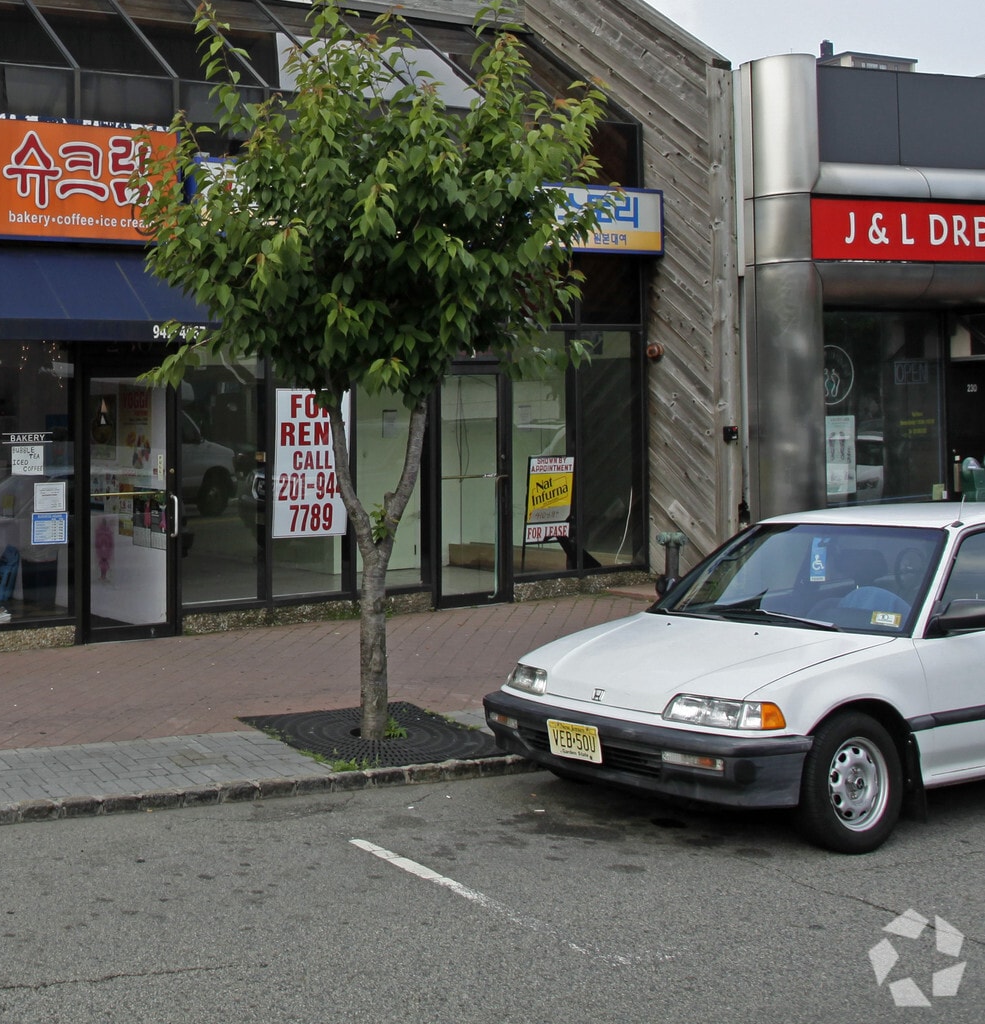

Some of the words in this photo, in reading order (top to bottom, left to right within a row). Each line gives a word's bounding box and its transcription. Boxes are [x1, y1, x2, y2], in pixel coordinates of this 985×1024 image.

[2, 130, 153, 209] 슈크림
[120, 218, 156, 228] crea
[844, 211, 856, 244] J
[868, 212, 889, 245] &
[900, 213, 915, 245] L
[966, 384, 978, 393] 230
[290, 394, 333, 419] FO
[10, 434, 45, 442] BAKERY
[292, 450, 333, 471] CALL
[531, 464, 572, 473] APPOINTMENT
[535, 477, 553, 492] Nat
[531, 484, 569, 507] Infurna
[289, 502, 334, 532] 7789
[527, 527, 542, 540] FOR
[544, 525, 568, 537] LEASE
